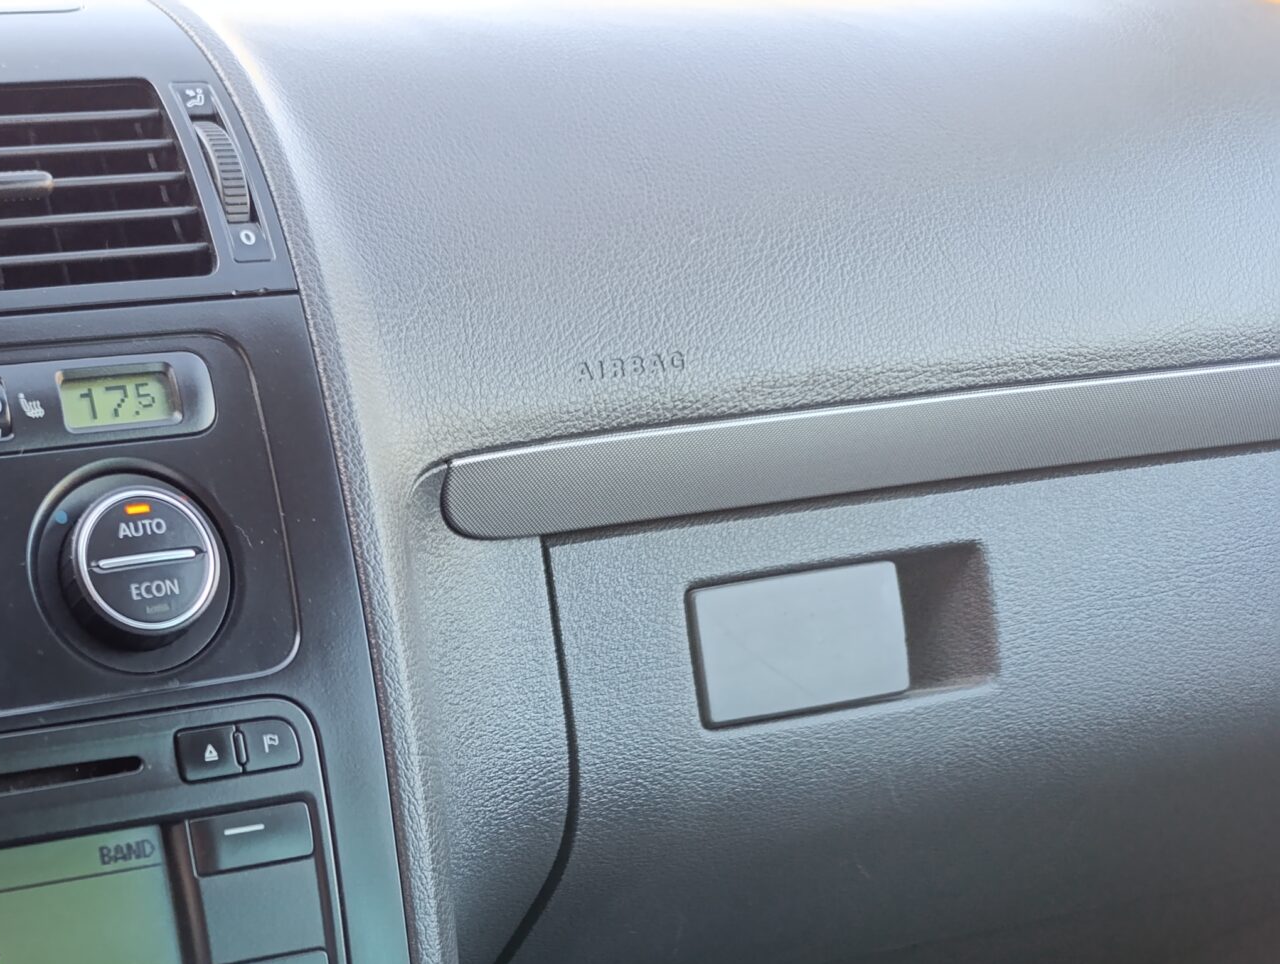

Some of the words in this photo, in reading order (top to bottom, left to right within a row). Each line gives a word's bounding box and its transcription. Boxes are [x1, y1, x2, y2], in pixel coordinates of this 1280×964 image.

[577, 350, 686, 383] AIRBAG
[118, 518, 167, 539] AUTO
[130, 578, 180, 601] ECON
[99, 839, 156, 866] BAND
